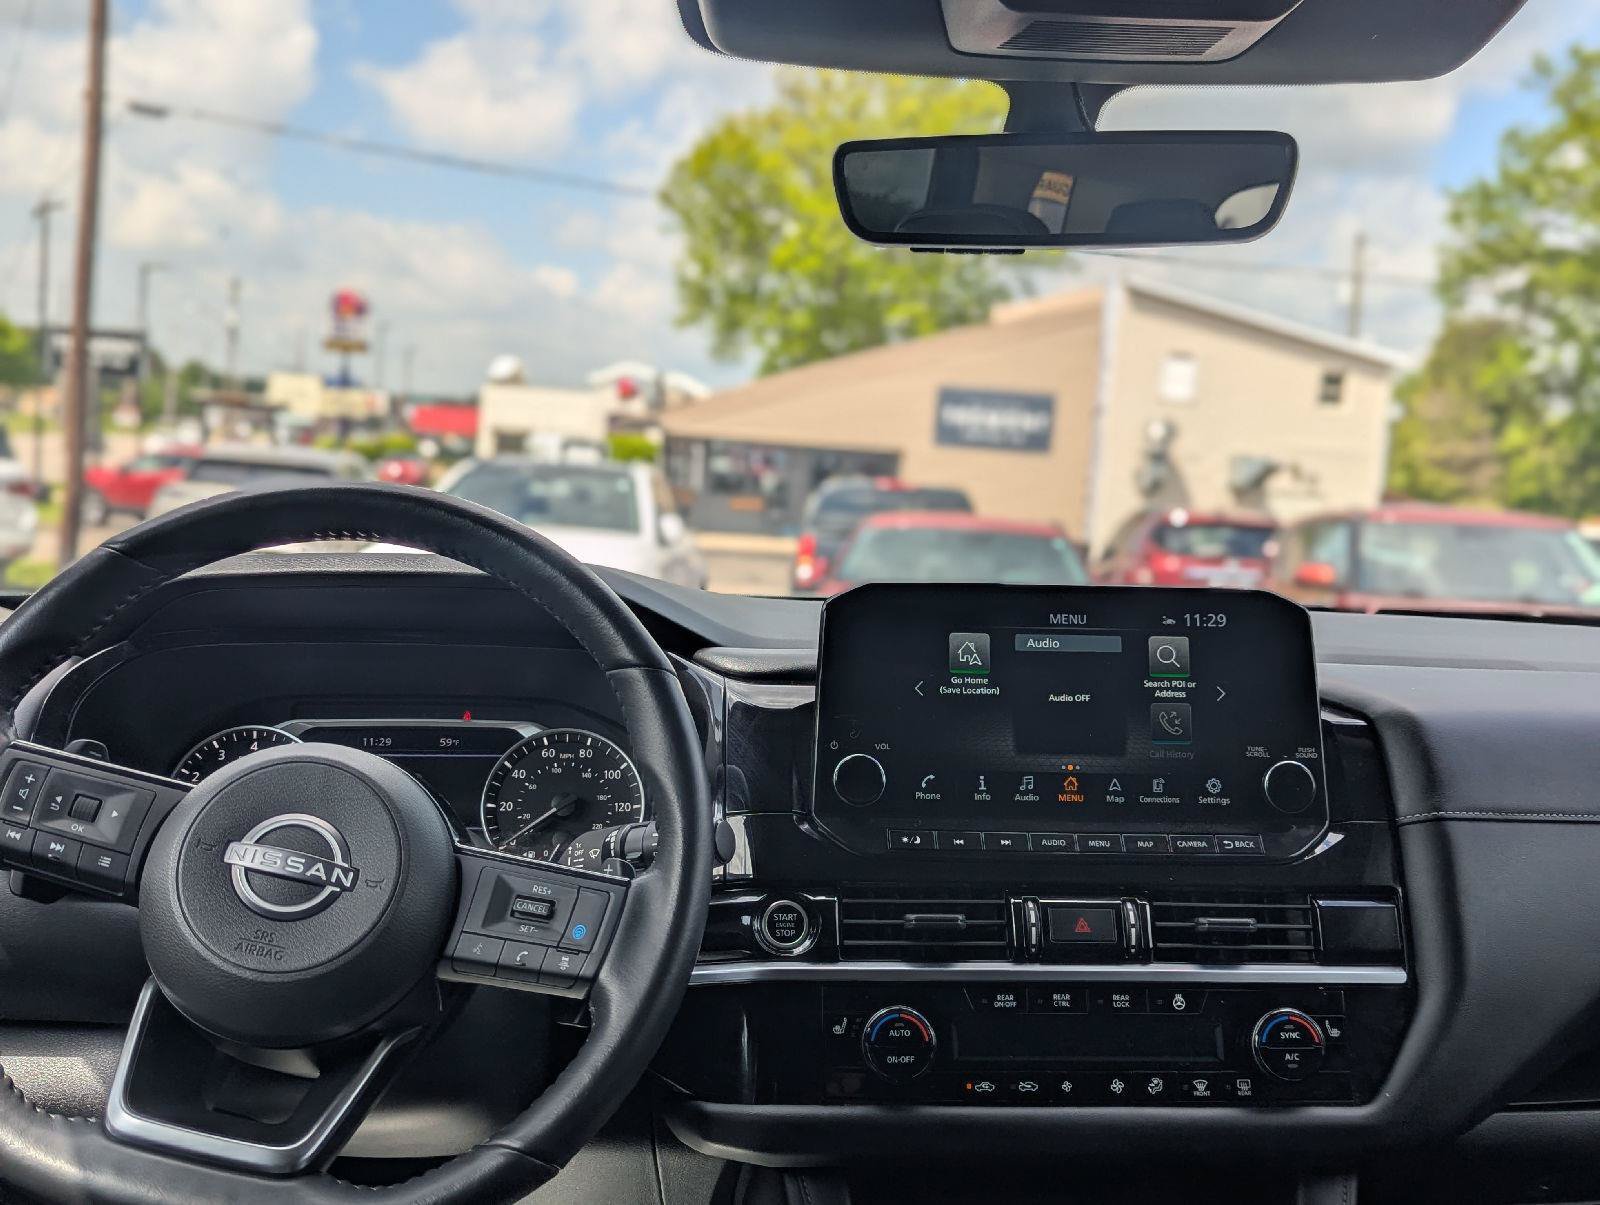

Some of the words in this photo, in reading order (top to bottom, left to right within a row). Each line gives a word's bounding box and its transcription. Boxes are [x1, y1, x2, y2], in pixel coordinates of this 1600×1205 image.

[1049, 613, 1087, 625] MENU
[1183, 613, 1227, 628] 11:29
[1026, 638, 1060, 649] Audio
[950, 676, 963, 684] Go
[965, 676, 989, 684] Home
[1143, 680, 1170, 688] Search
[939, 686, 961, 695] (Save
[962, 686, 1000, 696] Location)
[1154, 690, 1187, 698] Address
[1049, 694, 1074, 702] Audio
[1075, 694, 1091, 702] OFF
[250, 741, 258, 751] 4
[363, 737, 392, 747] 11:29
[218, 749, 226, 761] 3
[541, 748, 556, 758] 60
[579, 748, 593, 758] 80
[191, 771, 200, 782] 2
[511, 769, 526, 779] 40
[603, 769, 621, 780] 100
[915, 791, 941, 800] Phone
[974, 792, 991, 801] Info
[1014, 793, 1040, 802] Audio
[1058, 794, 1084, 802] MENU
[1106, 795, 1125, 804] Map
[1139, 795, 1180, 804] Connections
[1198, 795, 1231, 806] Settings
[499, 802, 513, 812] 20
[614, 802, 631, 812] 120
[522, 812, 531, 820] 20
[71, 823, 84, 833] OK
[1041, 838, 1066, 846] AUDIO
[1137, 840, 1154, 848] MAP
[1176, 840, 1209, 848] CAMERA
[1235, 840, 1256, 848] BACK
[574, 849, 584, 857] OFF
[228, 845, 354, 888] NISSAN
[515, 901, 549, 915] CANCEL
[773, 913, 797, 921] START
[253, 927, 276, 944] SRS
[775, 929, 796, 937] STOP
[234, 941, 284, 961] AIRBAG
[888, 1029, 911, 1037] AUTO
[1280, 1031, 1301, 1039] SYNC
[1284, 1053, 1300, 1061] A/C
